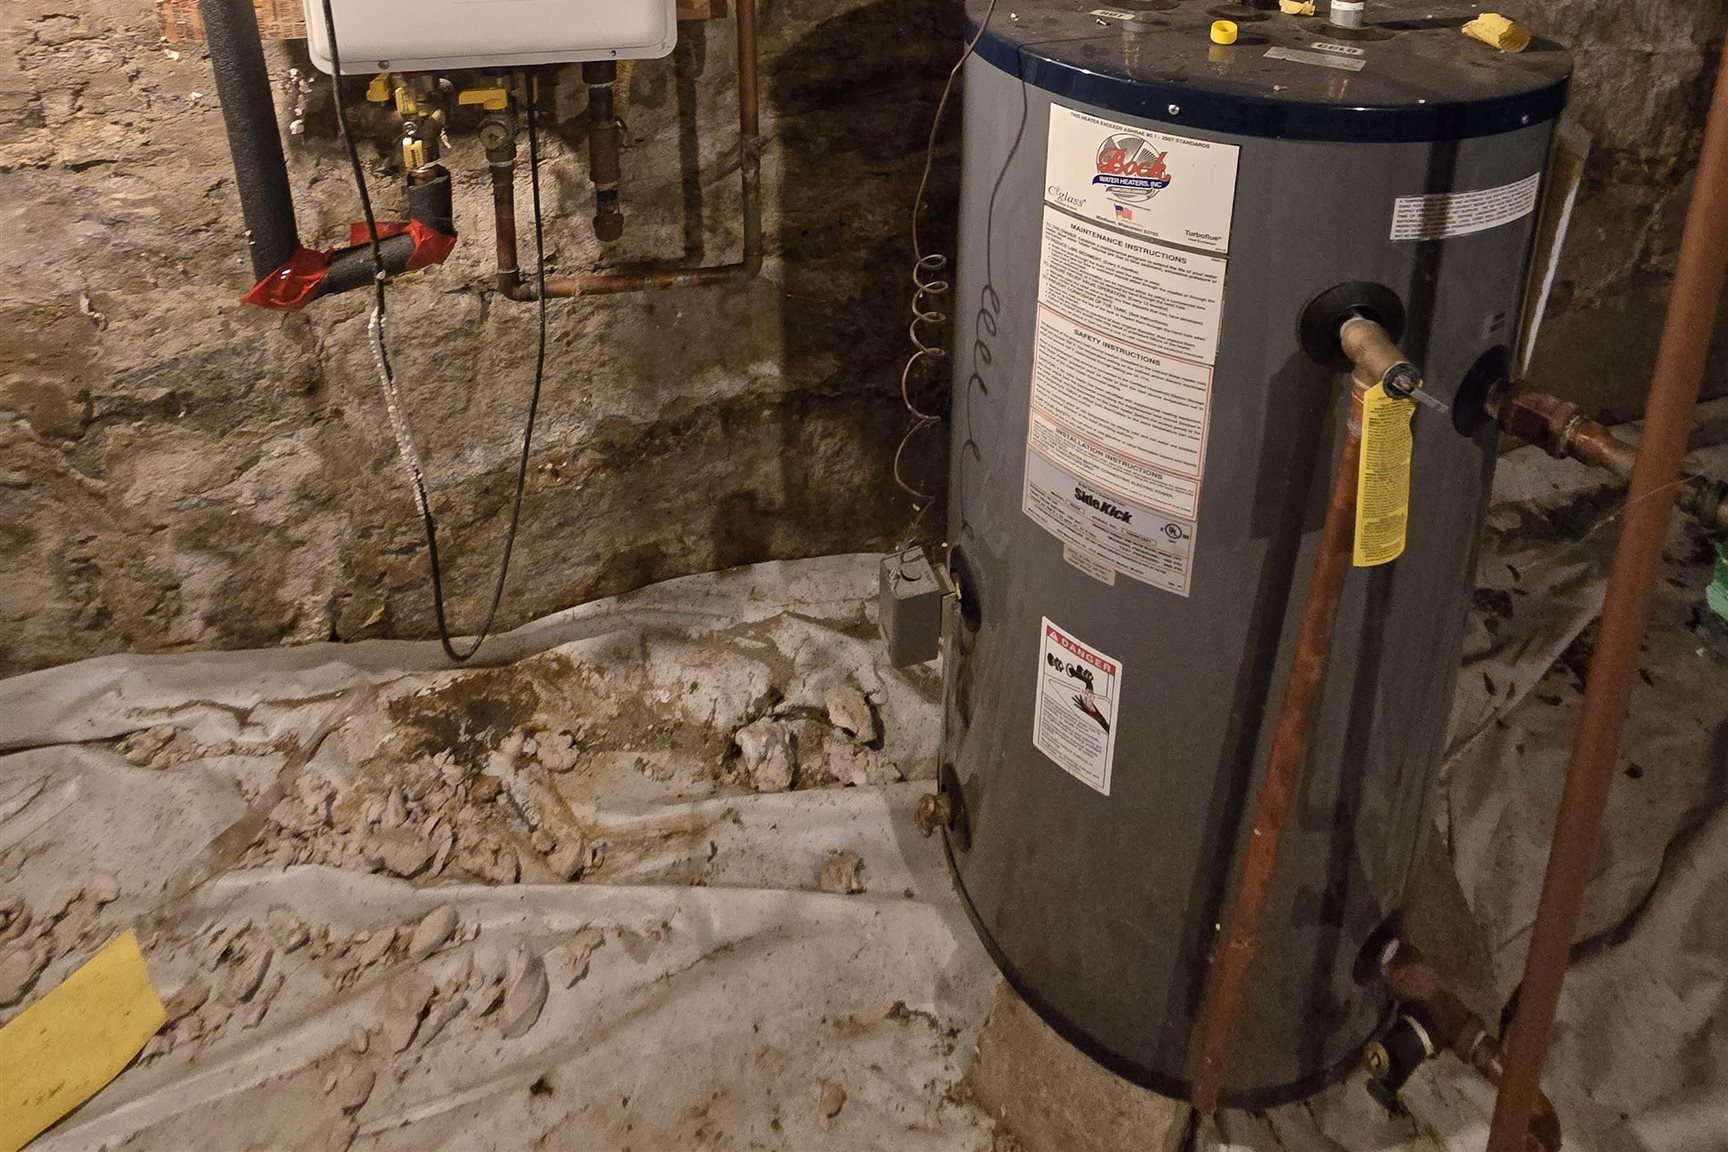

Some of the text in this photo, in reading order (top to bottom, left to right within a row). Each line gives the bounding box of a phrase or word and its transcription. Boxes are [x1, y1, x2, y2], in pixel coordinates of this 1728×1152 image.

[1097, 147, 1171, 182] Bock
[1099, 175, 1119, 185] WATER
[1150, 180, 1163, 189] INC
[1070, 223, 1123, 246] MAINTENANCE
[1124, 243, 1187, 264] INSTRUCTIONS
[1074, 329, 1160, 366] SAFETY INSTRUCTIONS
[1055, 429, 1103, 456] INSTALLATION
[1105, 454, 1162, 479] INSTRUCTIONS
[1074, 487, 1132, 523] SideKick
[1061, 638, 1111, 673] DANGER
